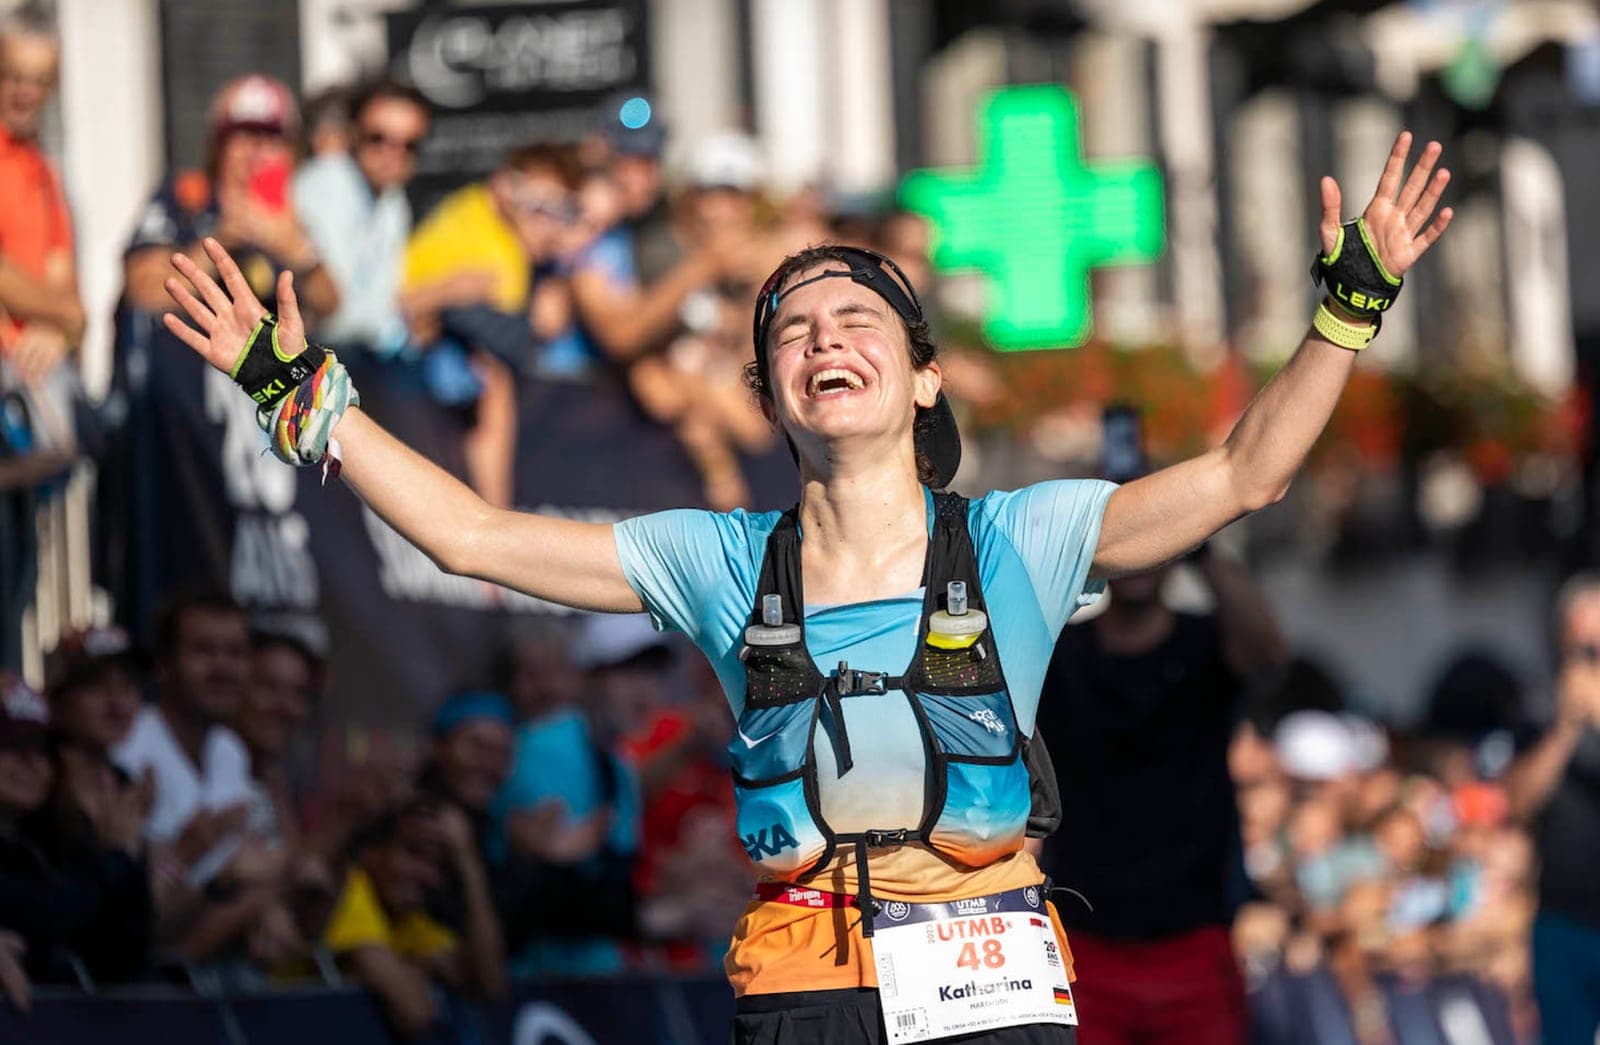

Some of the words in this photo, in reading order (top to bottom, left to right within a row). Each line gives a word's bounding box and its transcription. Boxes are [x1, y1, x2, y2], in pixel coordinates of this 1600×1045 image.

[1336, 282, 1390, 311] LEKI
[251, 378, 286, 404] EKI
[739, 823, 800, 862] KA
[956, 938, 1006, 971] 48
[938, 976, 1033, 1002] Katharina
